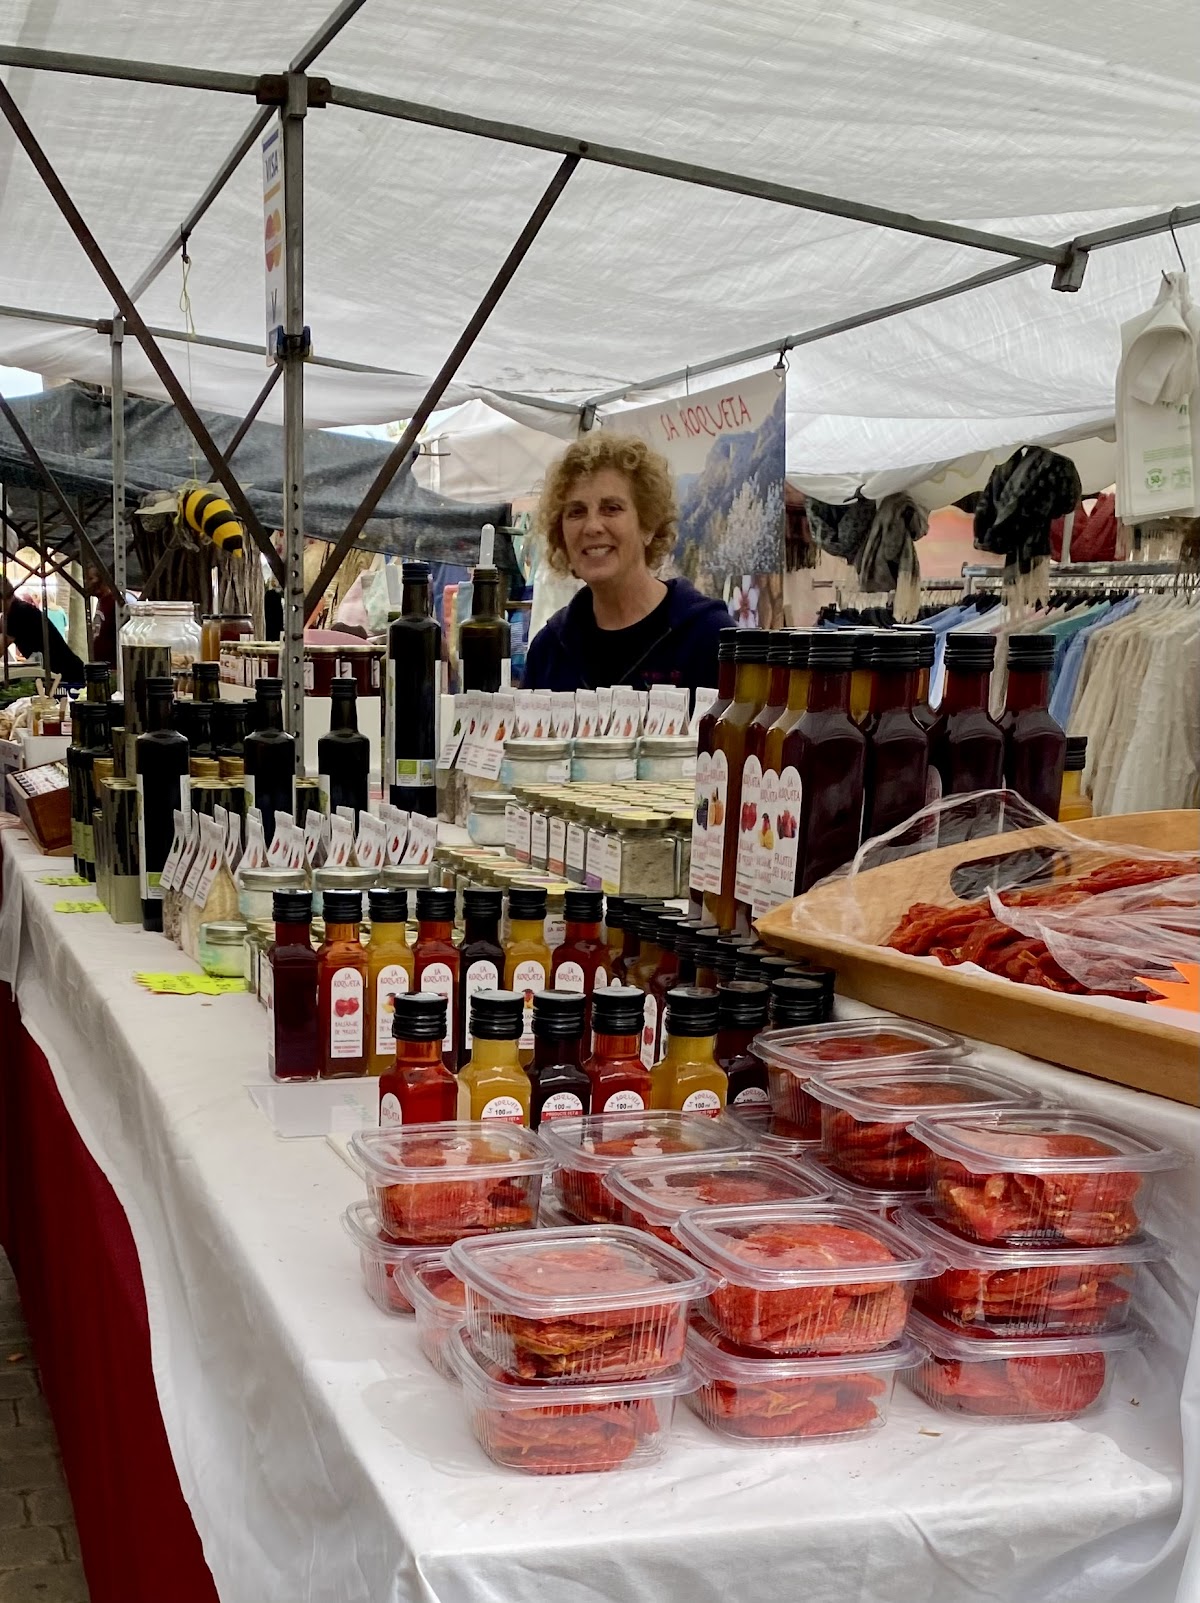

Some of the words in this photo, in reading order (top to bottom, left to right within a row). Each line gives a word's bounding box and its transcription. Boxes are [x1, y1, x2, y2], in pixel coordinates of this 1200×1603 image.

[265, 150, 279, 183] VISA
[679, 395, 752, 438] ROQUETA
[424, 974, 450, 983] ROQUETA
[469, 972, 496, 981] ROQUETA
[516, 973, 543, 982] ROQUETA
[558, 974, 582, 983] ROQUETA
[333, 980, 361, 989] ROQUETA
[380, 977, 407, 986] ROQUETA
